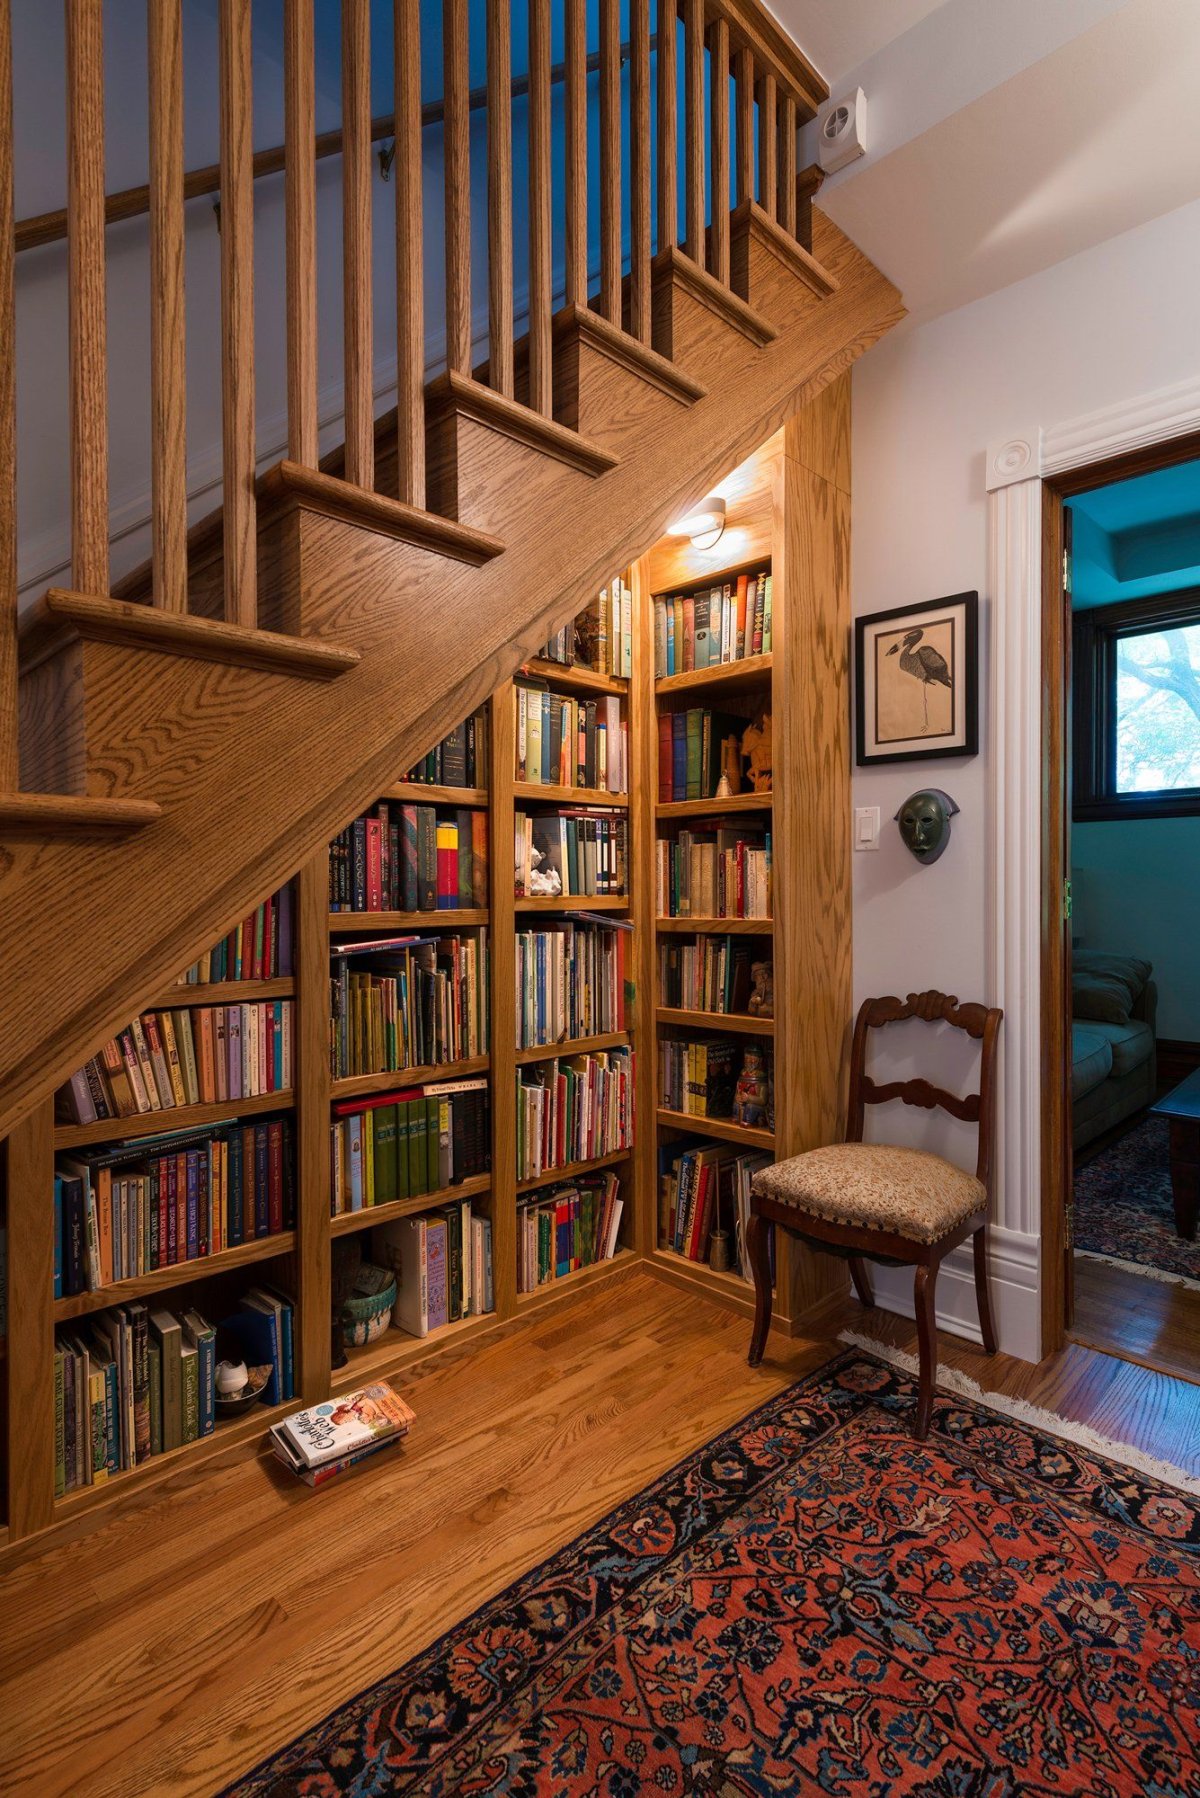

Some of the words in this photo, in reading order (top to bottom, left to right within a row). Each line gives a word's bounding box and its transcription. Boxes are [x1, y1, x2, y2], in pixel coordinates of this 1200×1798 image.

[687, 1210, 696, 1238] VENICE
[187, 1359, 195, 1372] The
[55, 1370, 63, 1395] HOME
[186, 1376, 195, 1403] Garden
[55, 1398, 63, 1424] GUIDE
[186, 1406, 194, 1426] Book
[294, 1411, 336, 1450] Charlotte's
[312, 1417, 337, 1435] Web
[55, 1436, 64, 1466] TREES
